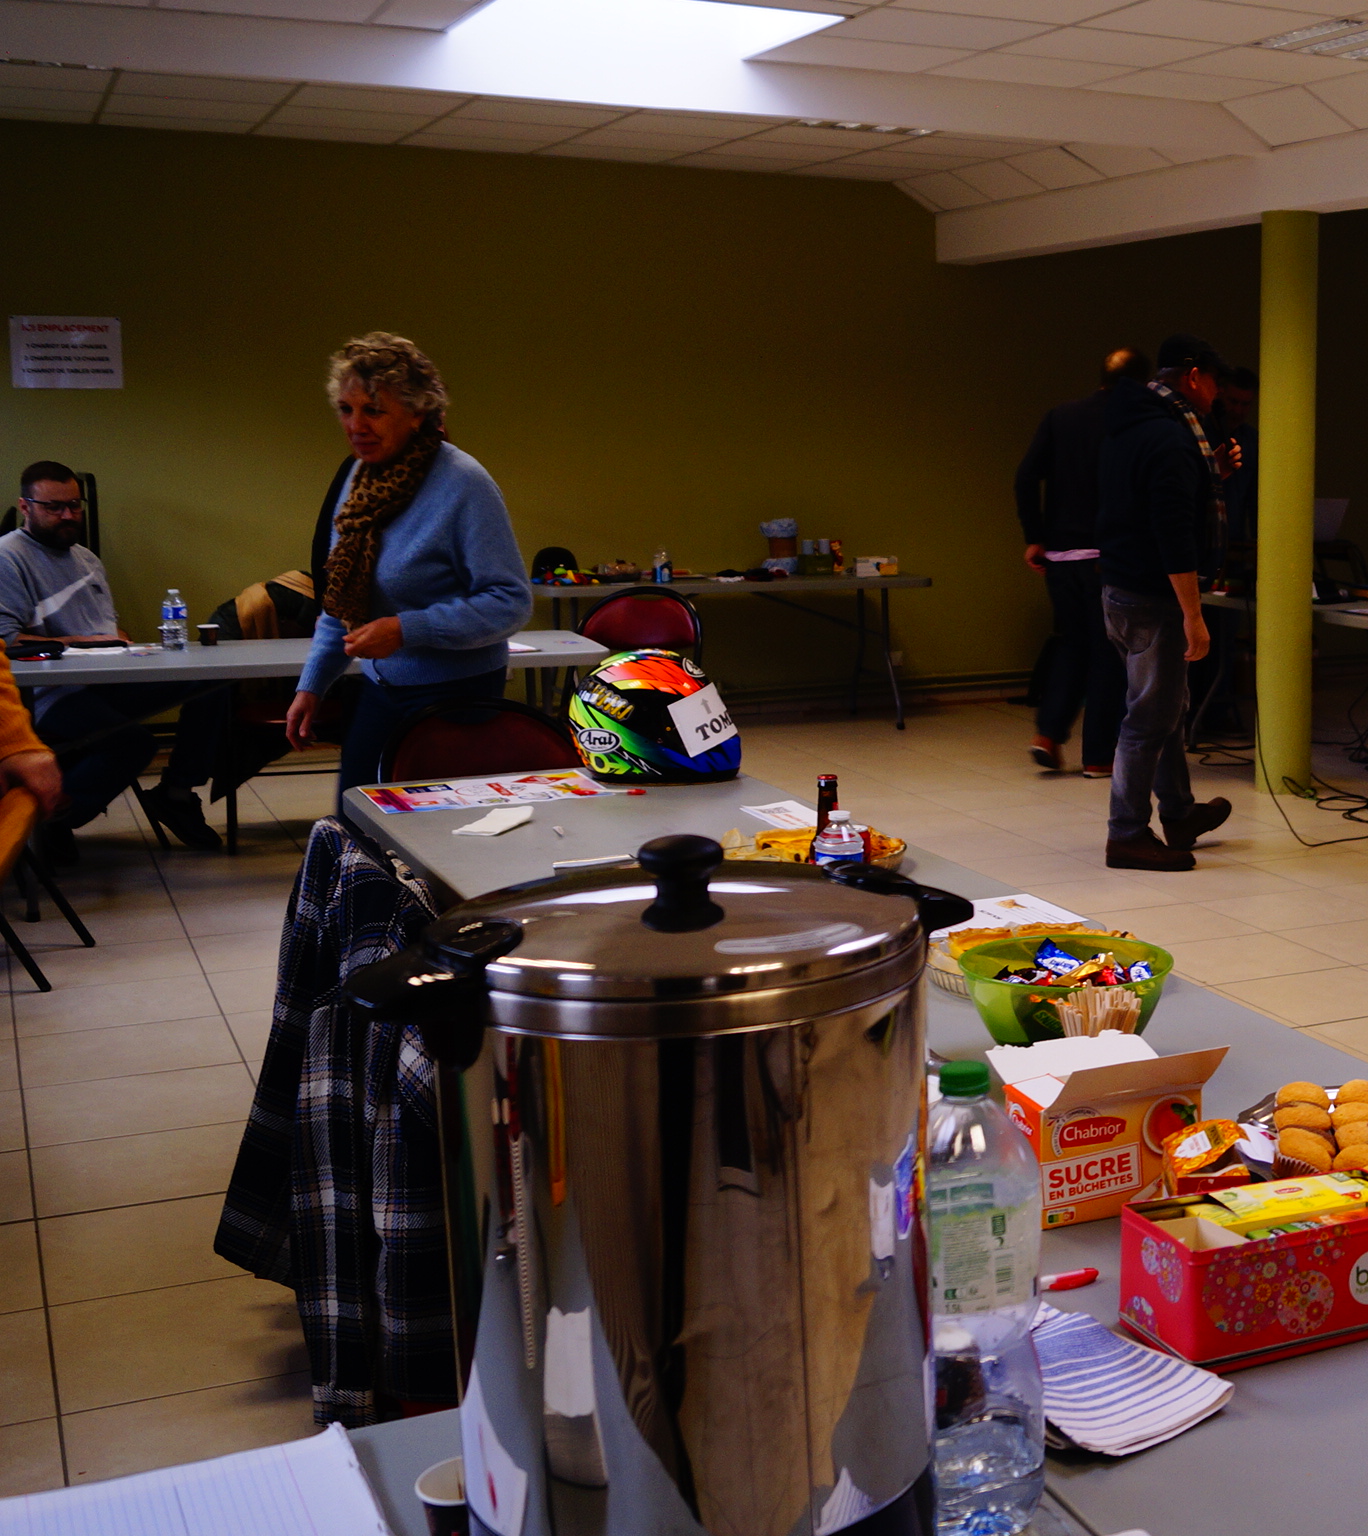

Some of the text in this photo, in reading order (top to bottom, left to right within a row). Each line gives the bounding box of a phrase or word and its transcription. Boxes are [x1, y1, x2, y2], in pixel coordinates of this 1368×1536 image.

[38, 324, 110, 333] EMPLACEMENT
[581, 732, 615, 746] Arai
[1062, 1118, 1122, 1142] Chabrior
[1048, 1152, 1132, 1189] SUCRE
[1048, 1172, 1134, 1201] EN BÛCHETTES
